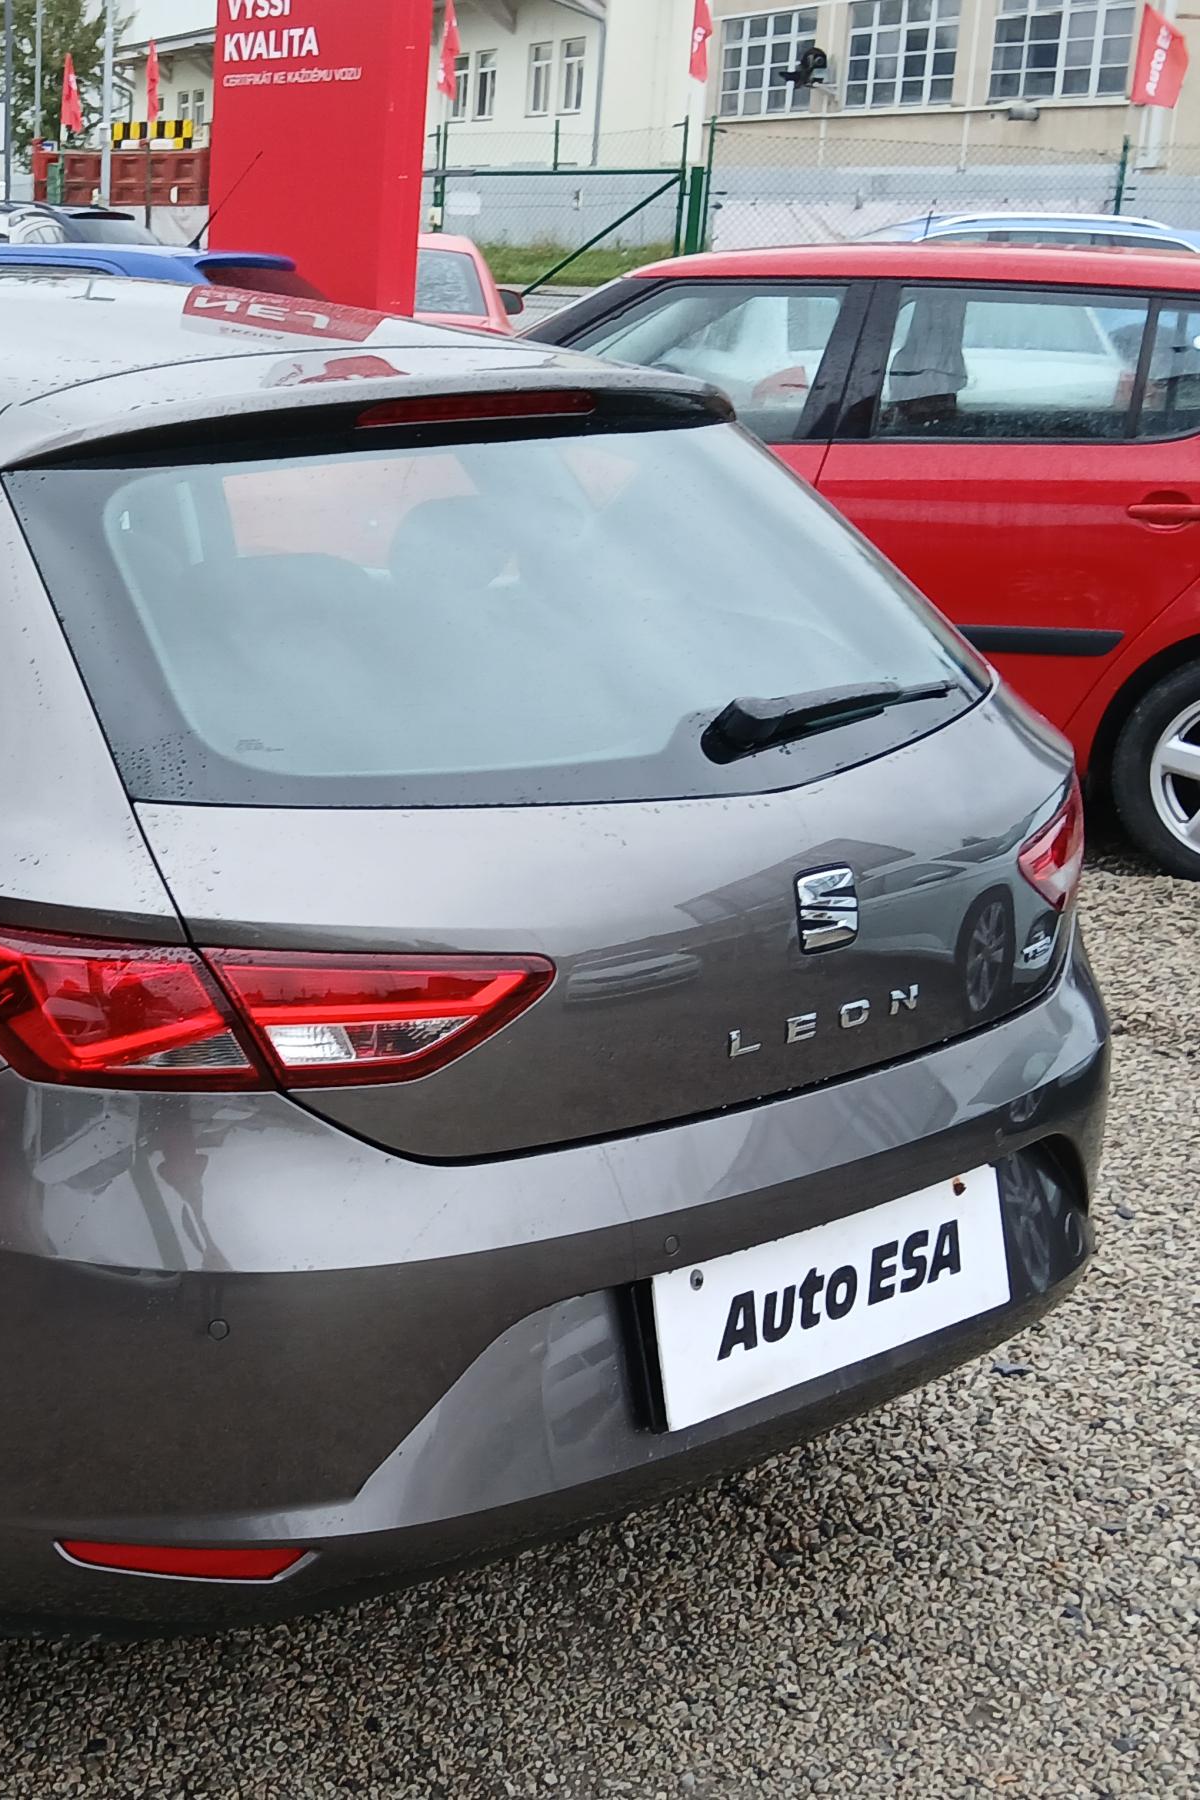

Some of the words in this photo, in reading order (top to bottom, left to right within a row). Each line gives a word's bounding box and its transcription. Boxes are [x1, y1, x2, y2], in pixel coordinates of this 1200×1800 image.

[223, 26, 320, 62] KVALITA
[727, 983, 920, 1058] LEON
[717, 1264, 858, 1361] Auto
[867, 1218, 961, 1306] ESA
